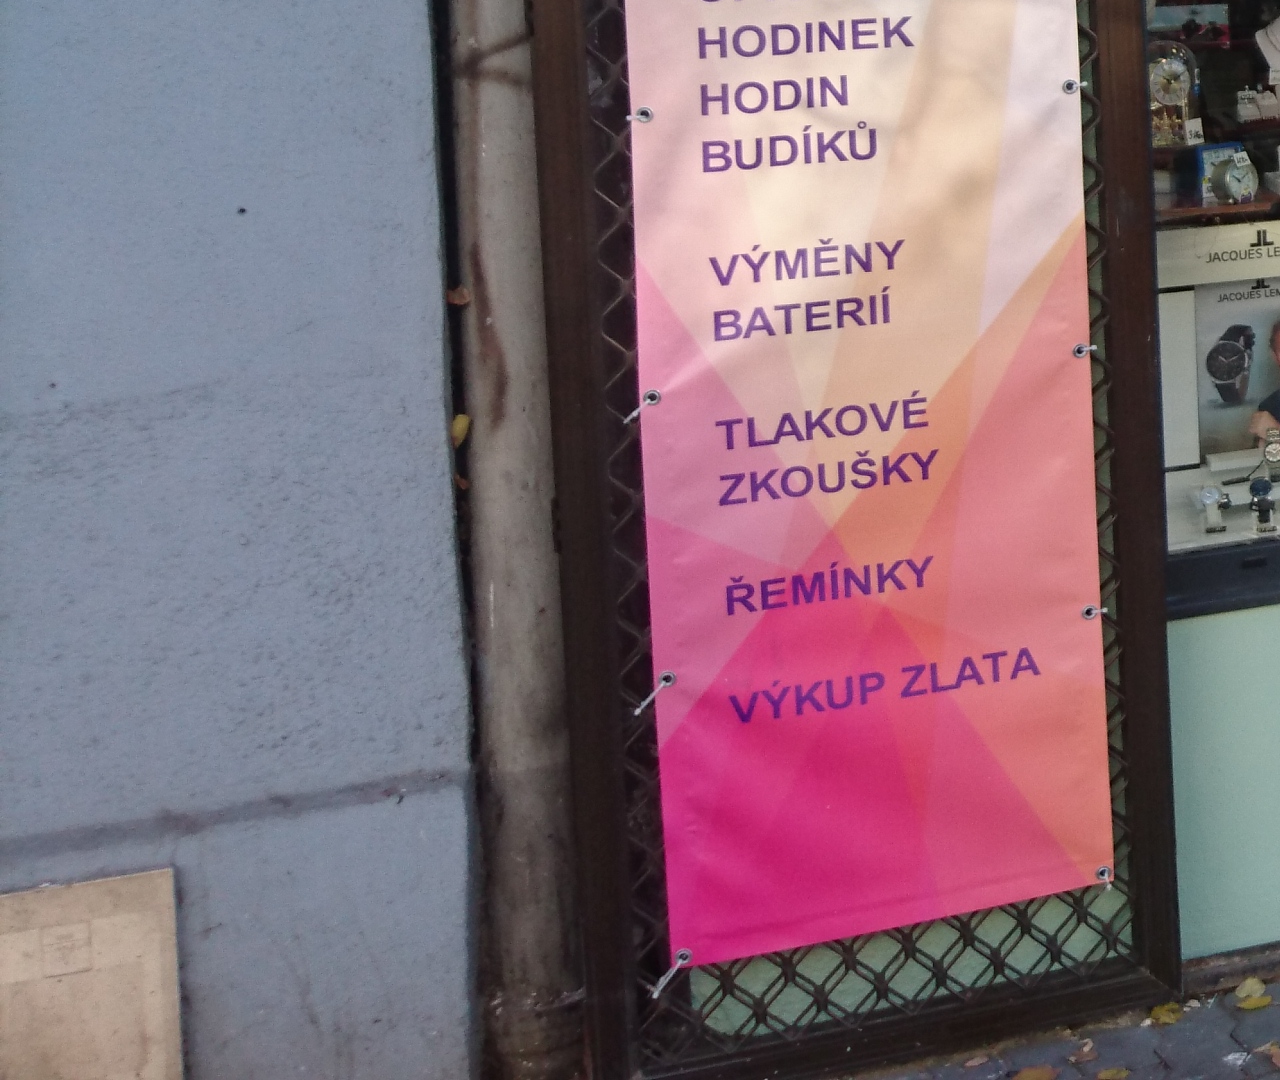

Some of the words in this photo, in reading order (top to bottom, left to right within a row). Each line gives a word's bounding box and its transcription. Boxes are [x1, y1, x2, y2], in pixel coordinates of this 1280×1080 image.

[698, 15, 914, 60] HODINEK
[700, 74, 849, 117] HODIN
[701, 120, 879, 173] BUDÍKŮ
[708, 238, 906, 288] VÝMĚNY
[1206, 247, 1263, 264] JACQUES
[713, 285, 892, 342] BATERIÍ
[1217, 291, 1261, 303] JACQUES
[715, 390, 930, 451] TLAKOVÉ
[718, 448, 940, 508] ZKOUŠKY
[726, 555, 935, 617] ŘEMÍNKY
[729, 670, 886, 724] VÝKUP
[900, 646, 1041, 700] ZLATA
